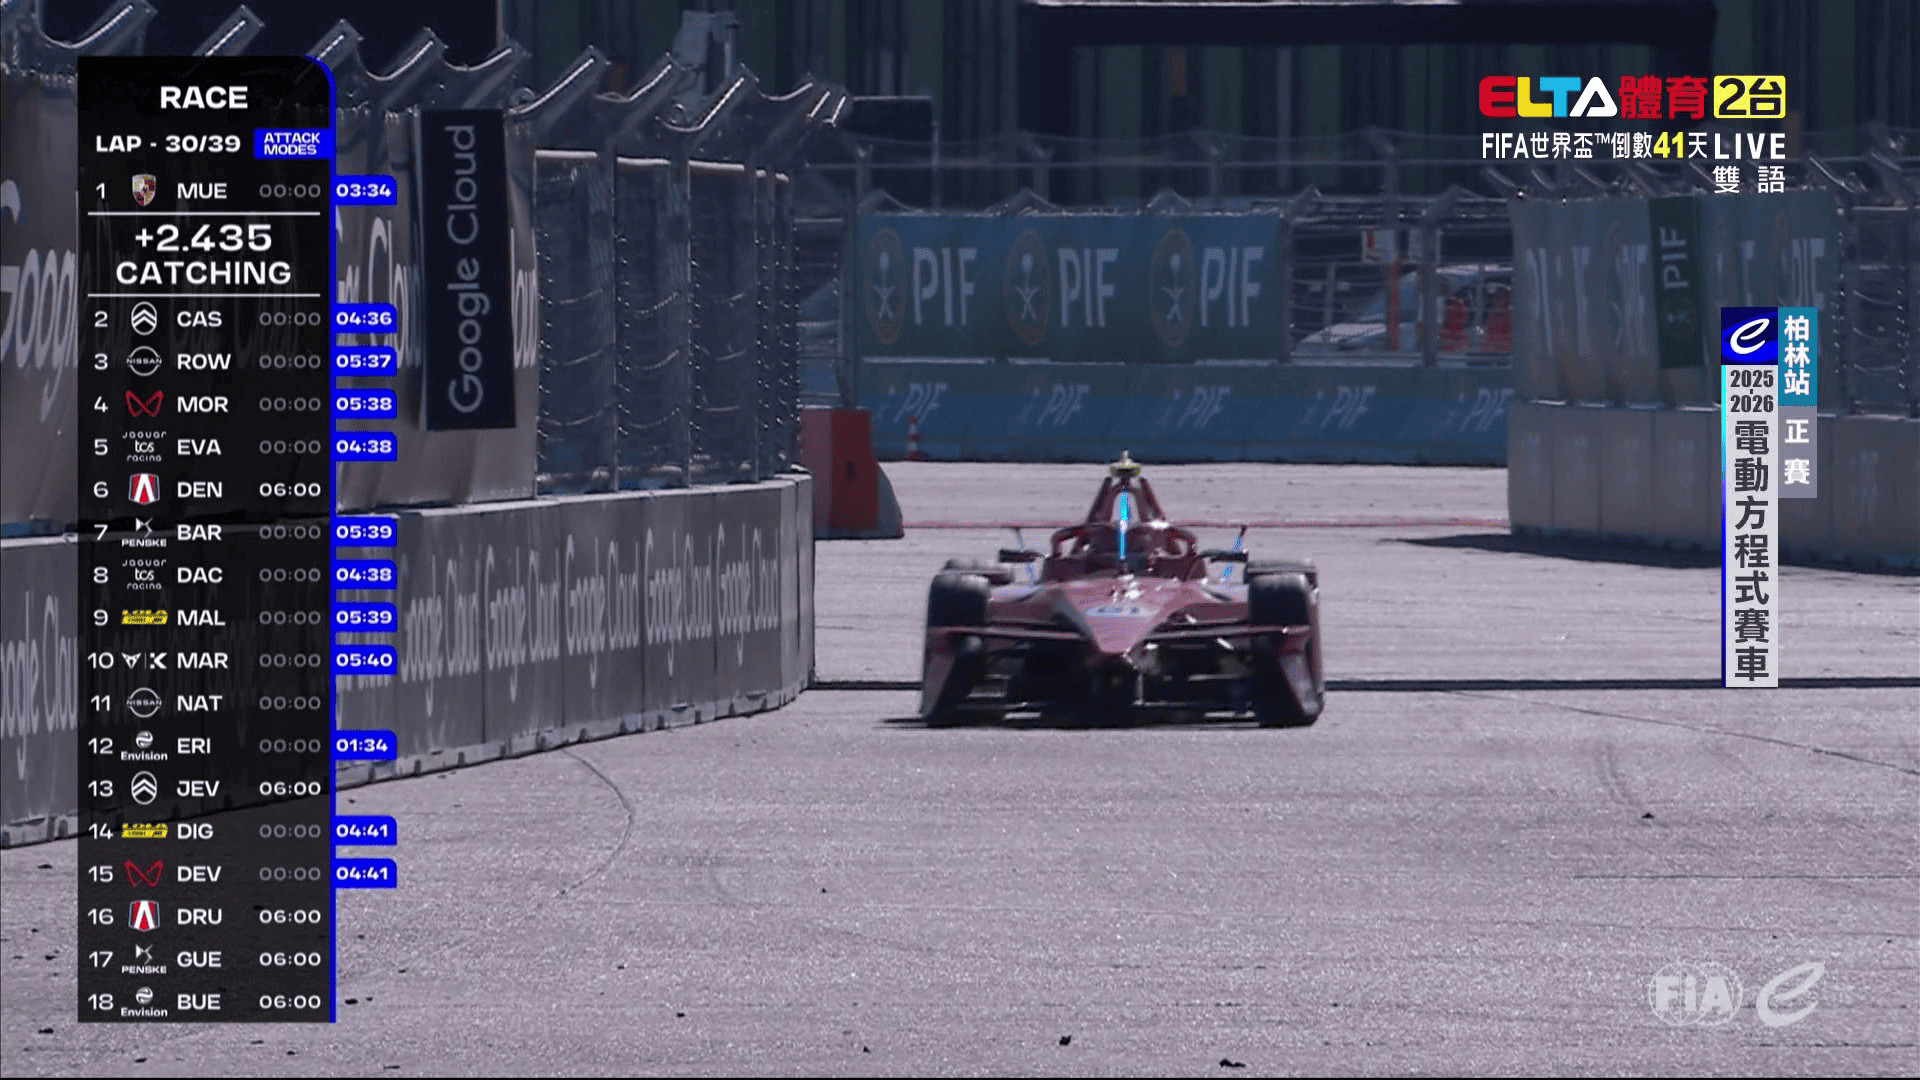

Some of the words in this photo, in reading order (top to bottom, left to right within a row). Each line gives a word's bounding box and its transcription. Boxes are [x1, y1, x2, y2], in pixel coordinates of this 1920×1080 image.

[445, 126, 479, 245] Cloud
[912, 247, 977, 326] PIF
[1058, 247, 1119, 327] PIF
[1200, 246, 1265, 327] PIF
[1660, 226, 1689, 289] PIF
[449, 256, 490, 412] Google
[894, 383, 948, 425] PIF
[1037, 383, 1091, 427] PIF
[1177, 385, 1231, 429] PIF
[1320, 385, 1376, 430] PIF
[485, 544, 526, 703] Google
[528, 548, 561, 663] Cloud
[566, 534, 606, 689] Google
[608, 540, 639, 650] Cloud
[645, 527, 683, 677] Google
[684, 532, 713, 641] Cloud
[717, 522, 751, 667] Google
[752, 528, 779, 632] Cloud
